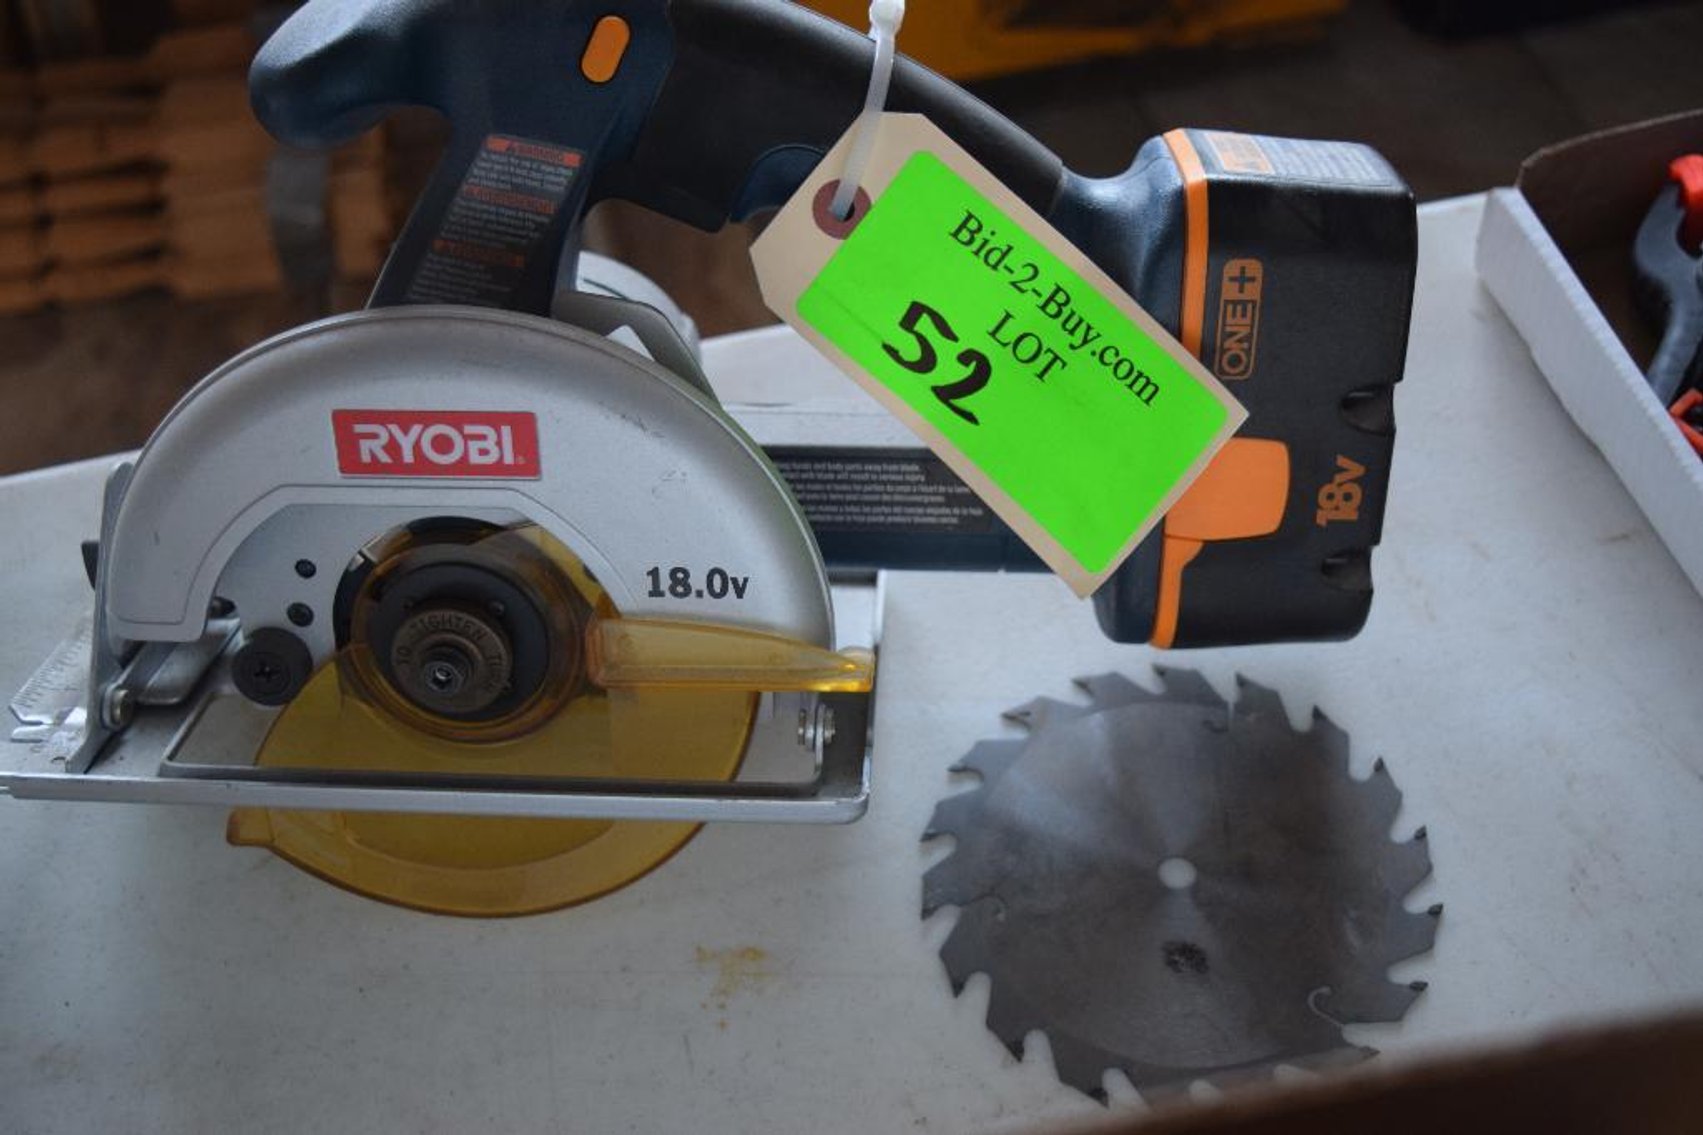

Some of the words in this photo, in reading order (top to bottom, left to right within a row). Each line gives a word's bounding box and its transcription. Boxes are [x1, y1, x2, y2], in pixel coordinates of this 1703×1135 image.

[949, 209, 1160, 406] Bid-2-Buy.com
[881, 300, 992, 426] 52
[986, 308, 1068, 384] LOT
[352, 423, 515, 465] RYOBI
[646, 566, 749, 599] 18.0v
